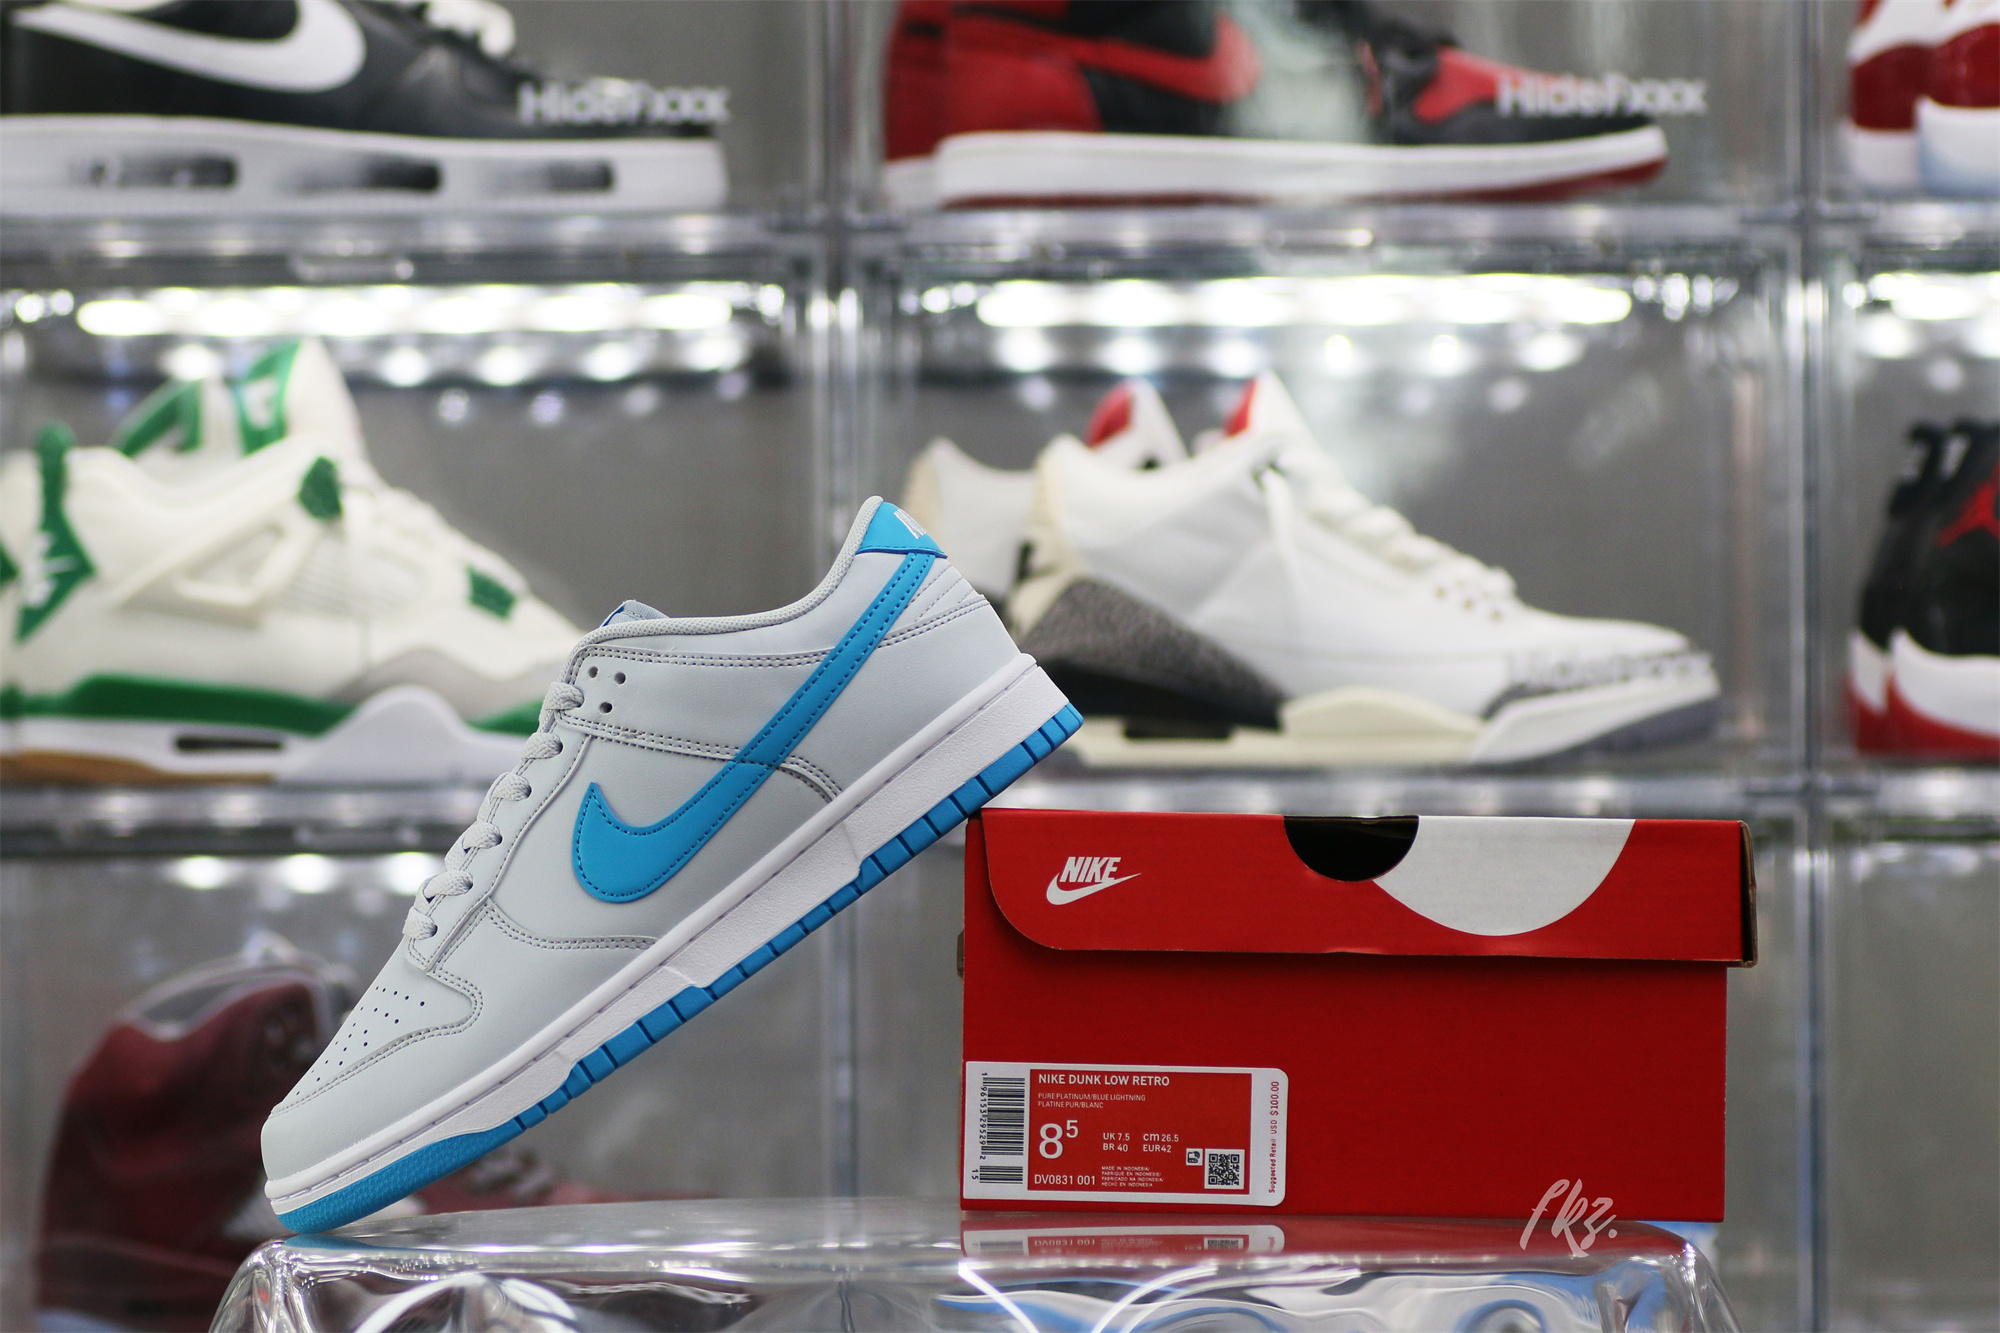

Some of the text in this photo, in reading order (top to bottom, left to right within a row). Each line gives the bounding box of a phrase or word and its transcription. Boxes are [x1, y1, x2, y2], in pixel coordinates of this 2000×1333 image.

[1059, 856, 1121, 883] NIKE
[1038, 1074, 1170, 1086] NIKE DUNK LOW RETRO
[1270, 1081, 1279, 1116] $100.00
[1065, 1101, 1104, 1109] PUR/BLANC
[1102, 1132, 1131, 1141] UK 7.5
[1142, 1133, 1179, 1142] cm 26.5
[1102, 1143, 1129, 1152] BR 40
[1034, 1174, 1096, 1185] DV0831 001
[1269, 1159, 1277, 1193] Suggested
